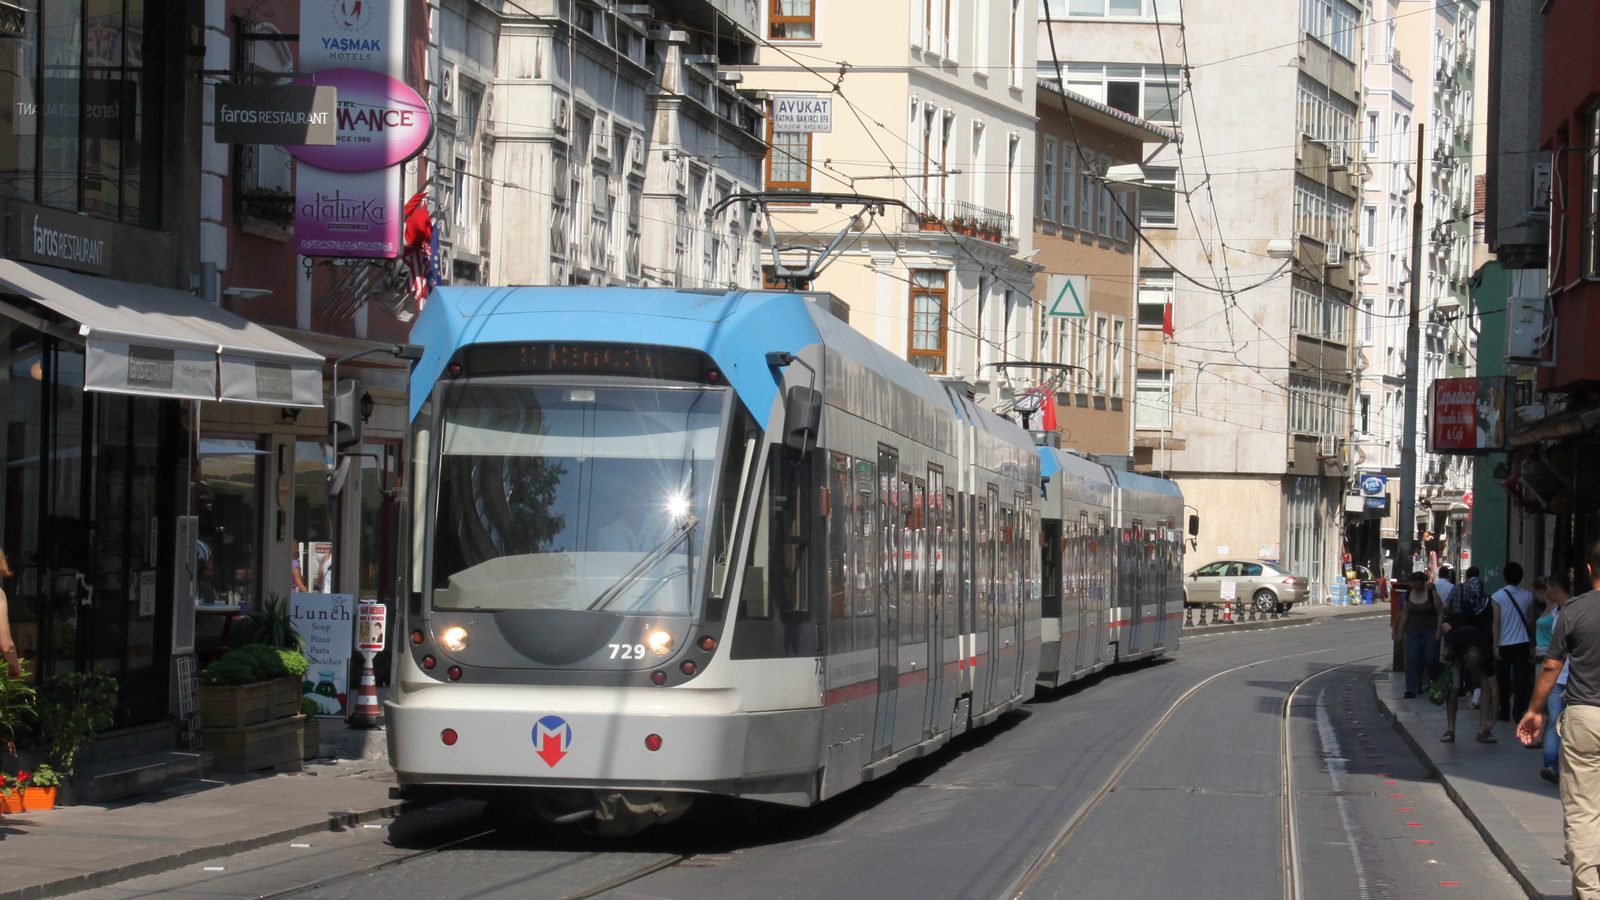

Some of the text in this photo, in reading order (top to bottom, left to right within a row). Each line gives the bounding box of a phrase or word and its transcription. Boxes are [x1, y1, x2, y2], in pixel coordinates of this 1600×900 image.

[321, 37, 381, 52] YAŞMAK
[329, 52, 373, 61] HOTELS
[779, 100, 828, 113] AVUKAT
[220, 104, 329, 125] faros RESTAURANT
[337, 108, 414, 132] MANCE
[820, 115, 829, 123] EFE
[337, 135, 352, 143] NCE
[33, 214, 104, 265] faros RESTAURANT
[294, 605, 350, 620] Lunch
[311, 623, 331, 632] Soup
[311, 635, 330, 644] Pizza
[310, 646, 330, 654] Pasta
[608, 643, 646, 660] 729
[308, 656, 341, 666] ndwiches
